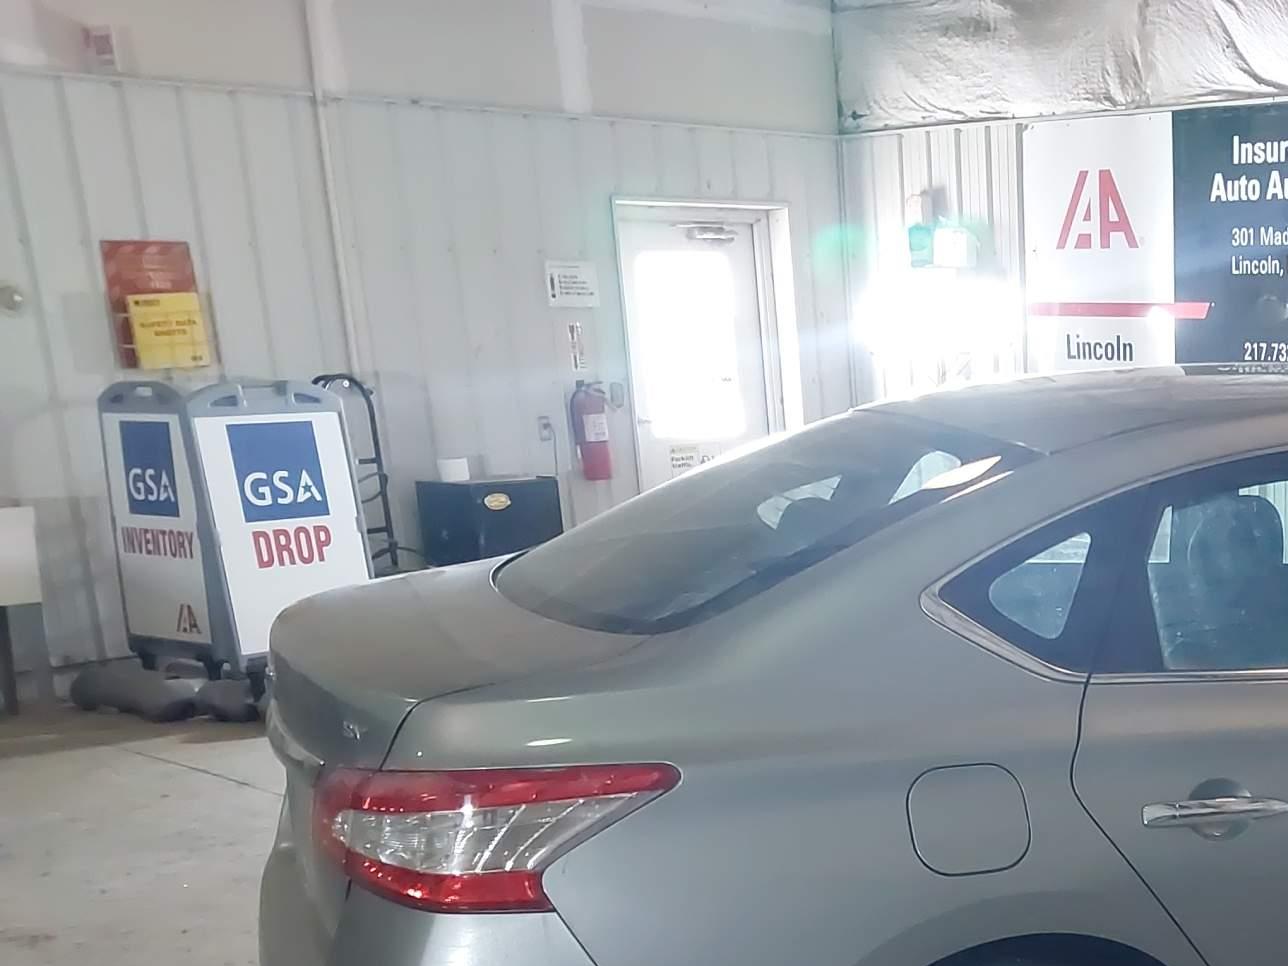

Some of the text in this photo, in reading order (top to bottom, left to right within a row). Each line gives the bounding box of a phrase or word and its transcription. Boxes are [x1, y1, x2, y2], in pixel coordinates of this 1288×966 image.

[1210, 172, 1260, 202] Auto
[1231, 227, 1254, 247] 301
[1231, 255, 1284, 277] Lincoln,
[1066, 333, 1134, 361] Lincoln
[128, 467, 176, 503] GSA
[243, 468, 323, 507] GSA
[121, 527, 195, 560] INVENTORY
[252, 525, 332, 569] DROP
